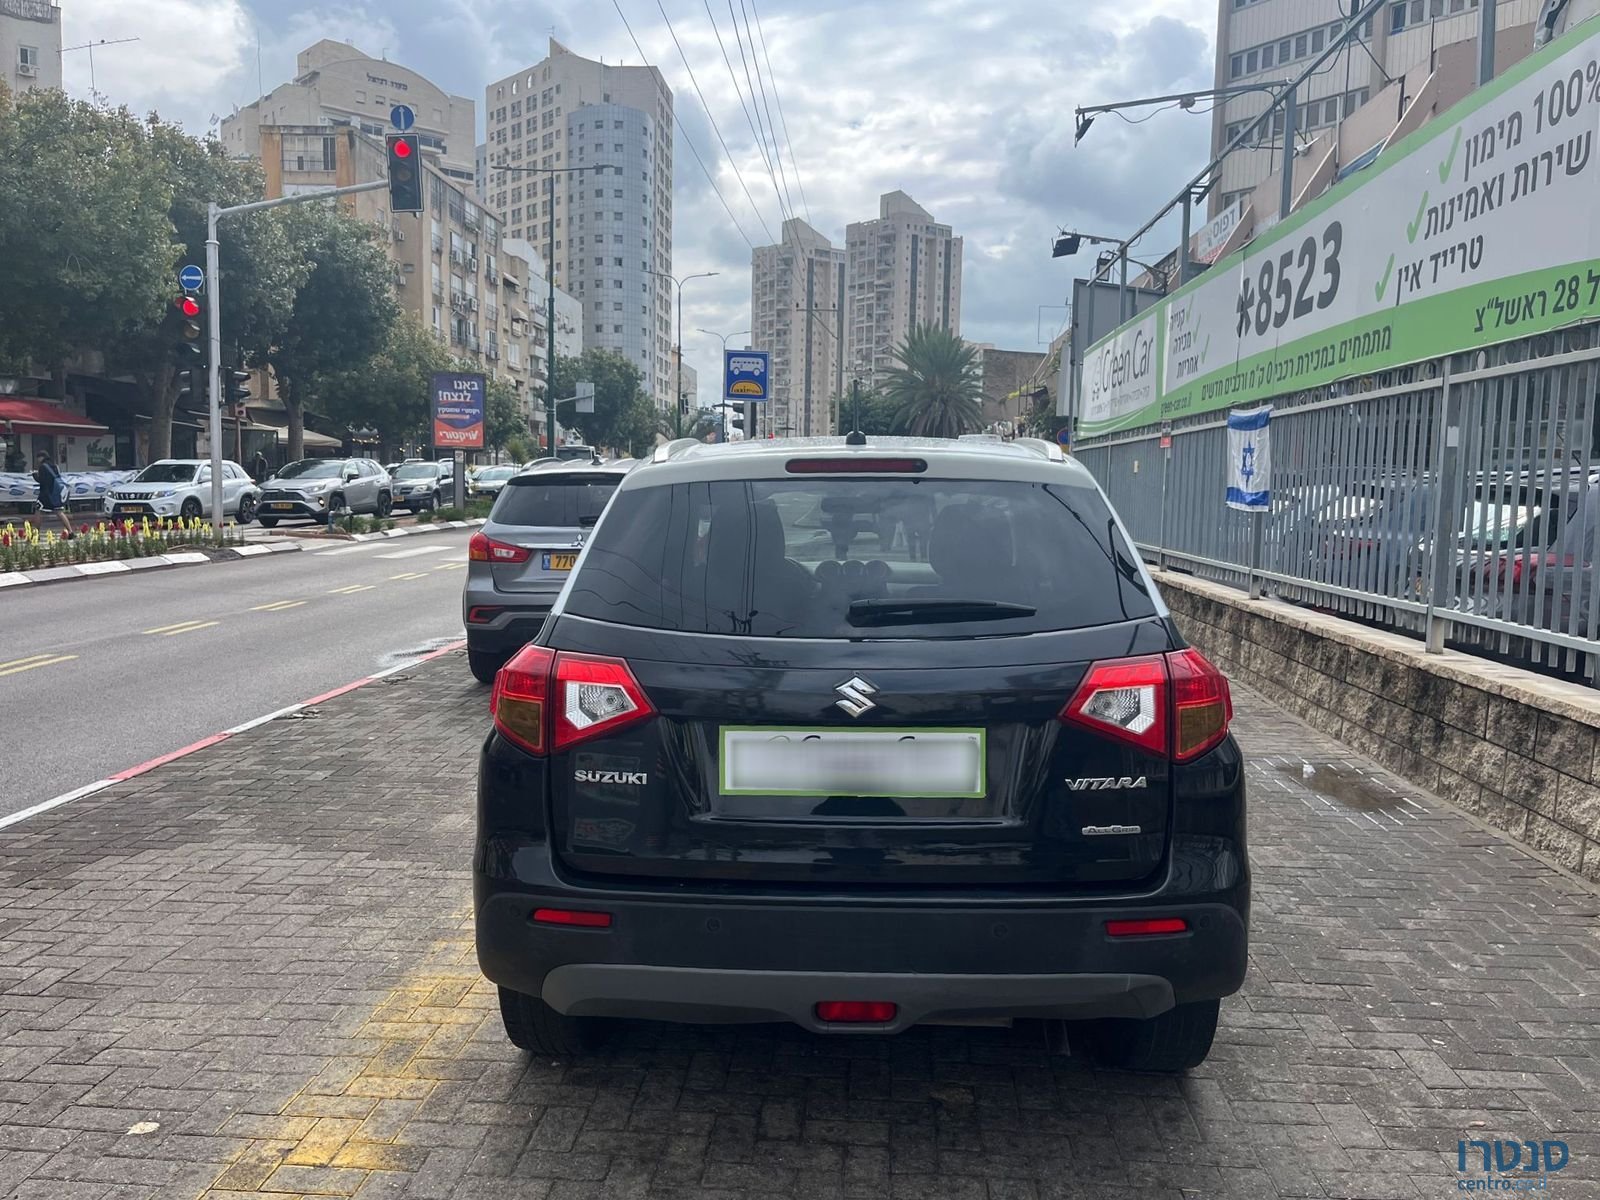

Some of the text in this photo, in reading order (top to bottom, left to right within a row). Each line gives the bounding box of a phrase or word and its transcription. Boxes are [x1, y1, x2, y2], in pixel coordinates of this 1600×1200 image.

[1464, 60, 1600, 182] 100% מימון
[1424, 130, 1592, 240] שירות ואמינות
[1212, 208, 1235, 239] דפוס
[1396, 235, 1484, 307] טרייד אין
[1552, 275, 1580, 314] 28
[1338, 324, 1392, 364] מתמחים
[1102, 329, 1154, 393] Green Car
[1274, 357, 1294, 383] רכבי
[1295, 344, 1336, 376] במכירת
[438, 390, 472, 401] לנצח!
[453, 380, 479, 391] באנו
[1201, 379, 1224, 401] חדשים
[1224, 371, 1248, 395] ורכבים
[574, 769, 648, 785] SUZUKI
[1065, 776, 1148, 791] VITARA
